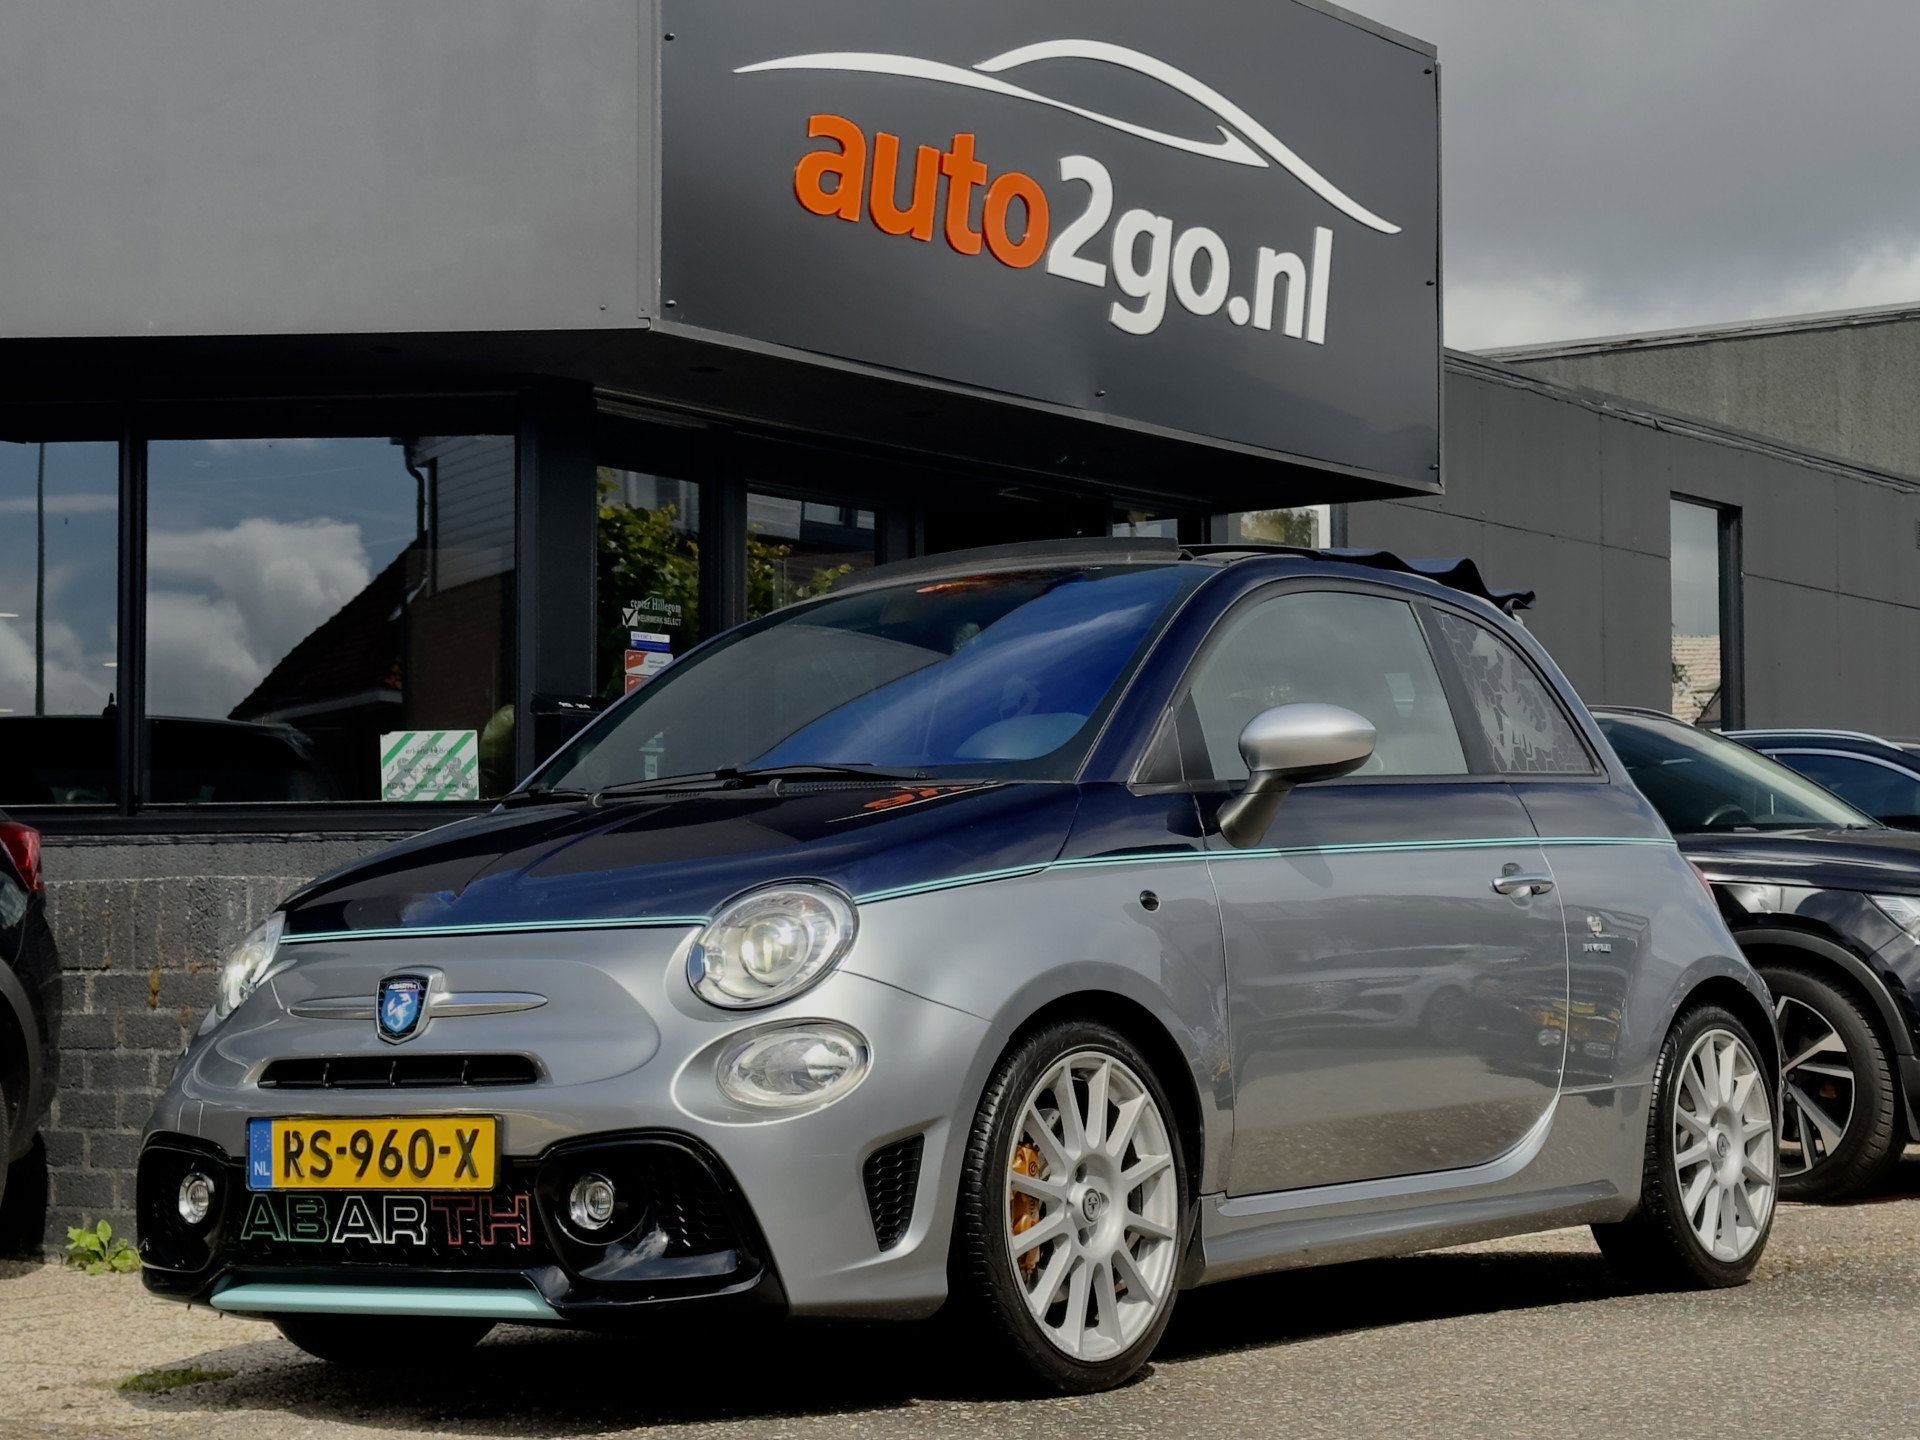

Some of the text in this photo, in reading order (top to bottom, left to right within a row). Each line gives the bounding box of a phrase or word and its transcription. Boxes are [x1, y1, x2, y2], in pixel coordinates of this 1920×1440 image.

[794, 112, 1334, 345] auto2go.nl
[652, 598, 681, 617] Hillegom
[664, 617, 681, 625] SELECT
[254, 1128, 480, 1179] NL RS-960-X
[240, 1193, 532, 1246] ABARTH
